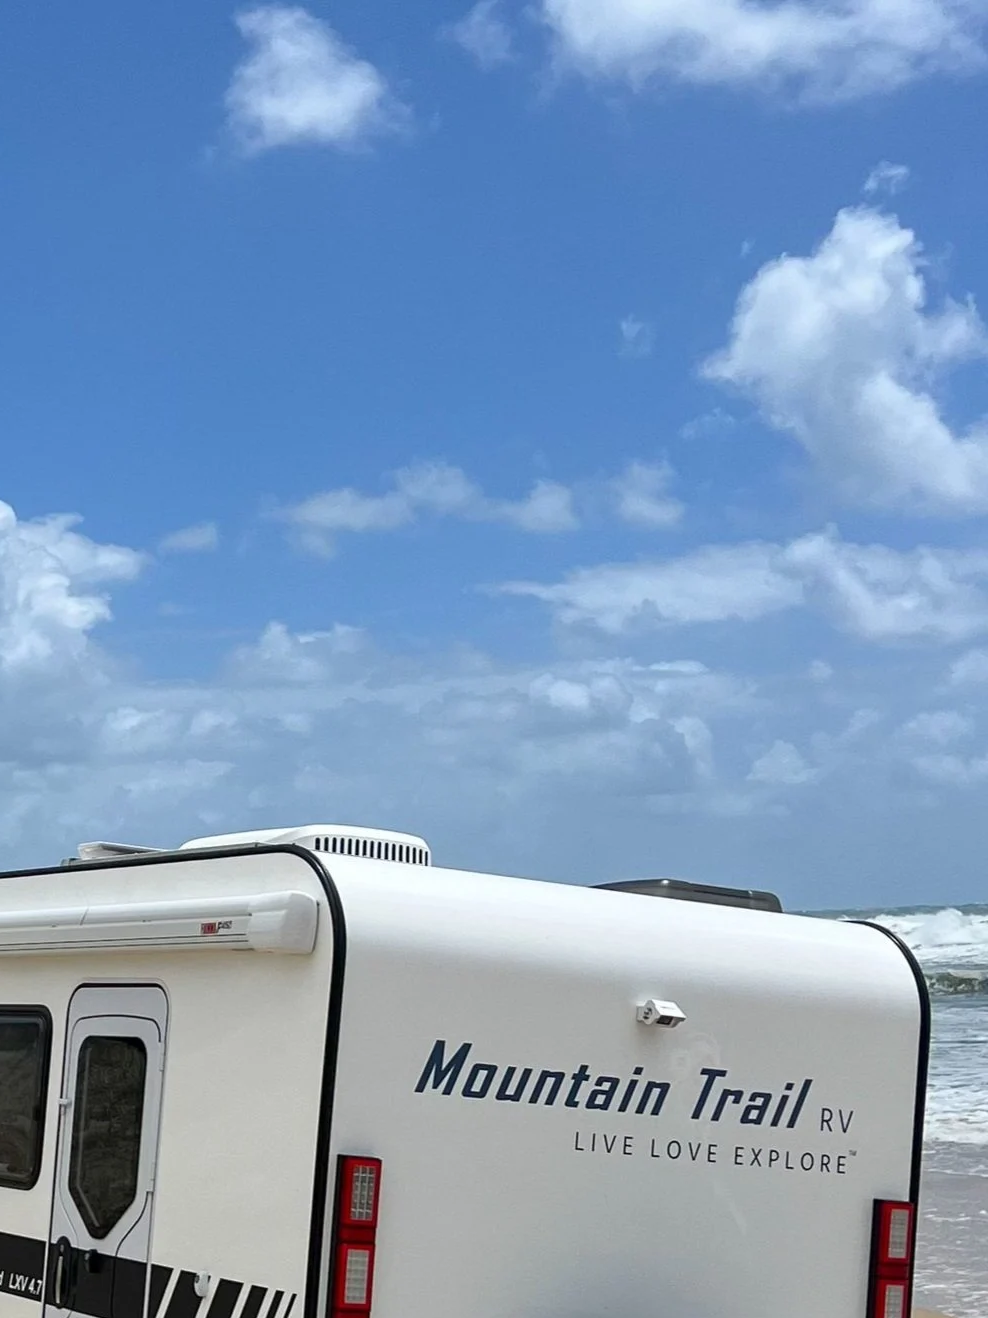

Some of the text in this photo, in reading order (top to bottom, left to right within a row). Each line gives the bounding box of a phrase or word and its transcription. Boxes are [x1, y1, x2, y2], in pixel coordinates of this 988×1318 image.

[415, 1039, 854, 1134] Mountain Trail RV
[575, 1131, 634, 1155] LIVE
[651, 1138, 718, 1164] LOVE
[8, 1272, 29, 1292] LXV
[28, 1278, 43, 1295] 4.7
